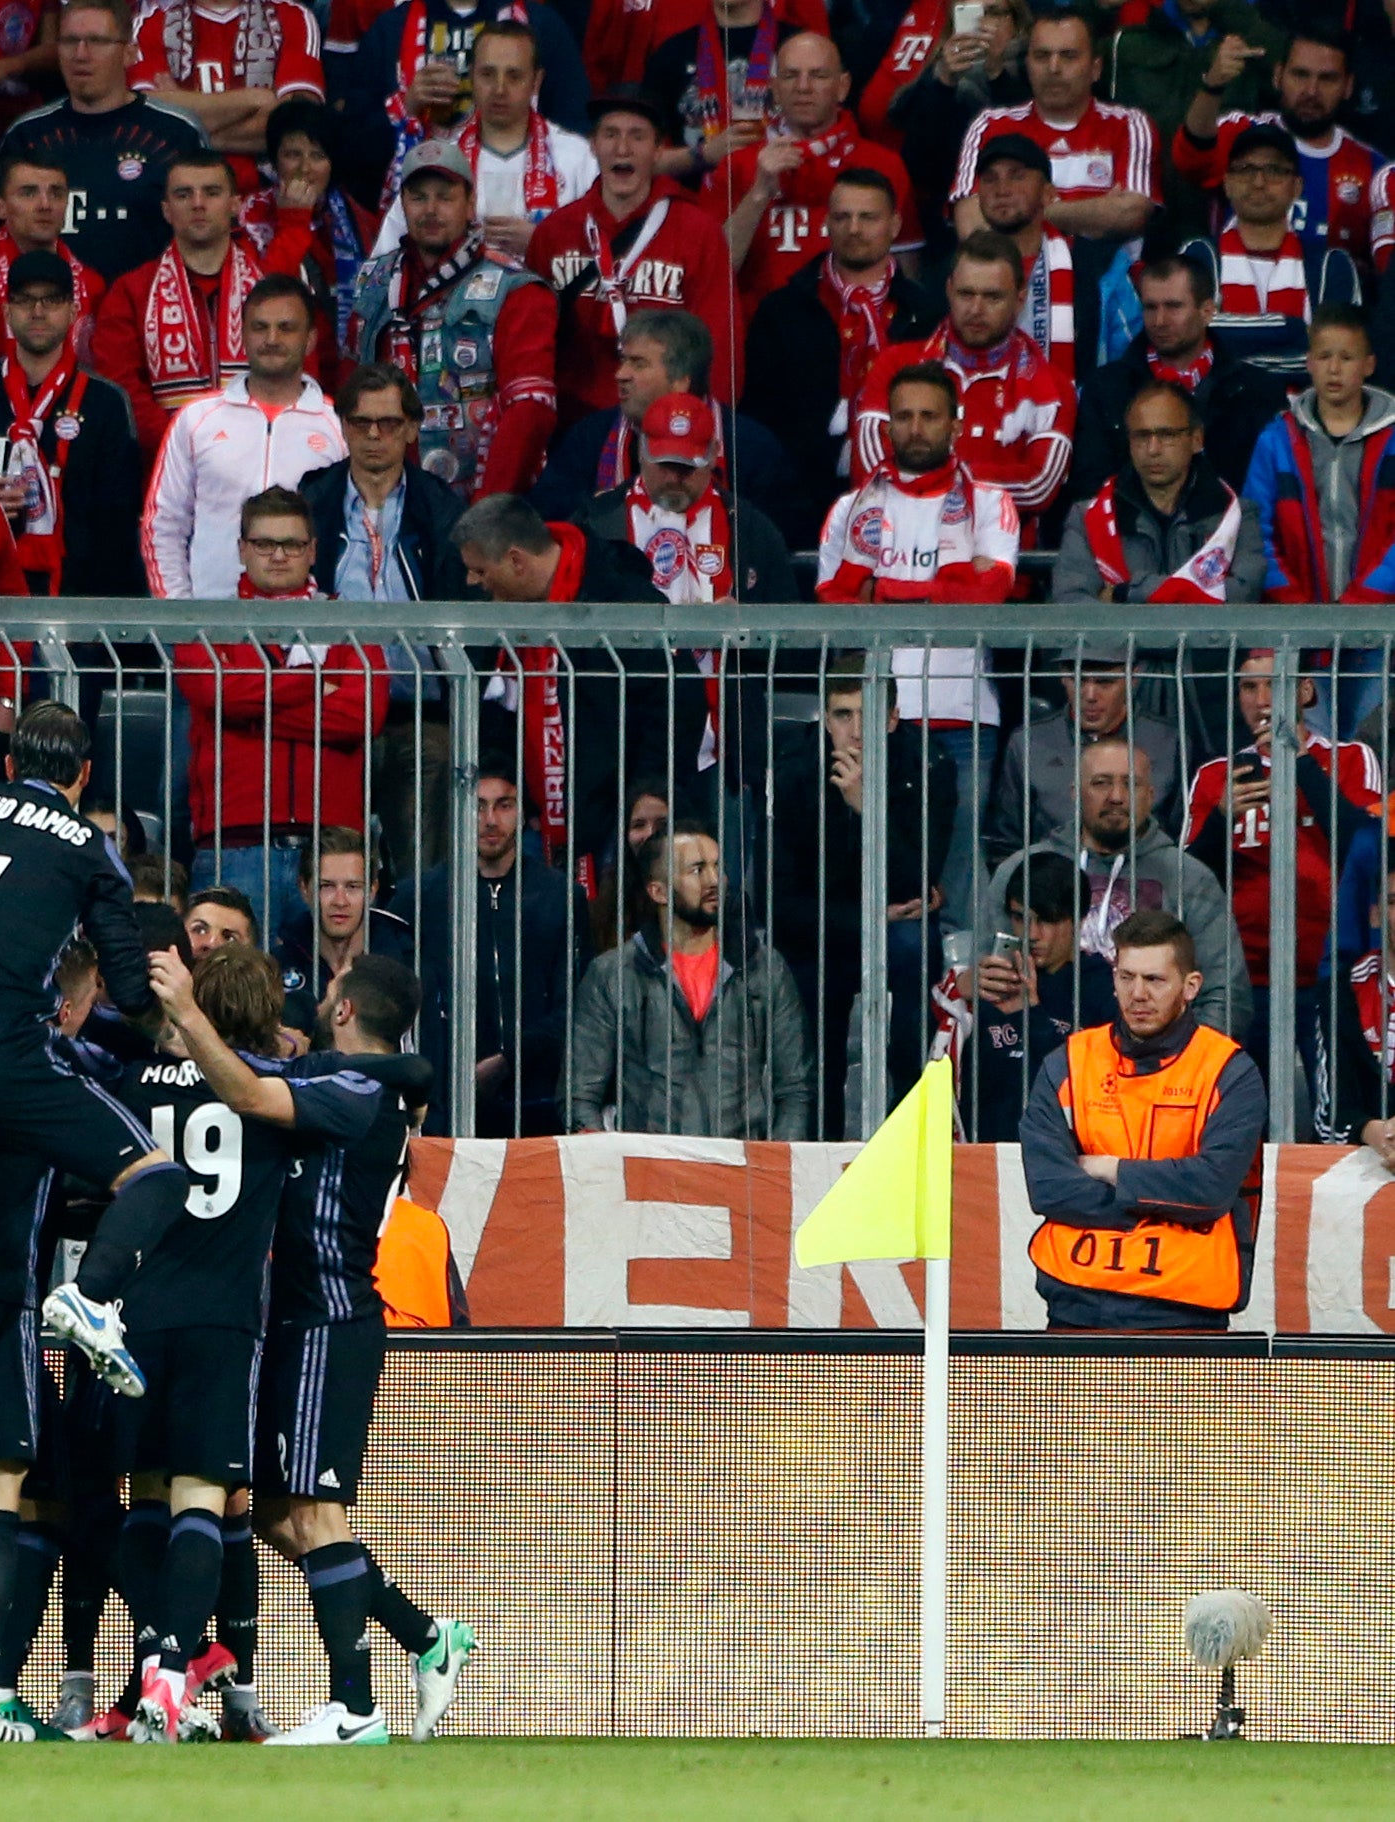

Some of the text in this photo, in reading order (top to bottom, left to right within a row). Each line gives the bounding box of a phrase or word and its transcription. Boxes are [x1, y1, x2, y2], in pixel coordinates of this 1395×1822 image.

[769, 207, 808, 252] T
[552, 251, 685, 300] SÜRVE
[163, 331, 189, 374] FC
[13, 802, 93, 846] RAMOS
[141, 1059, 206, 1087] MODR
[151, 1102, 244, 1220] 19
[1070, 1232, 1163, 1276] 011
